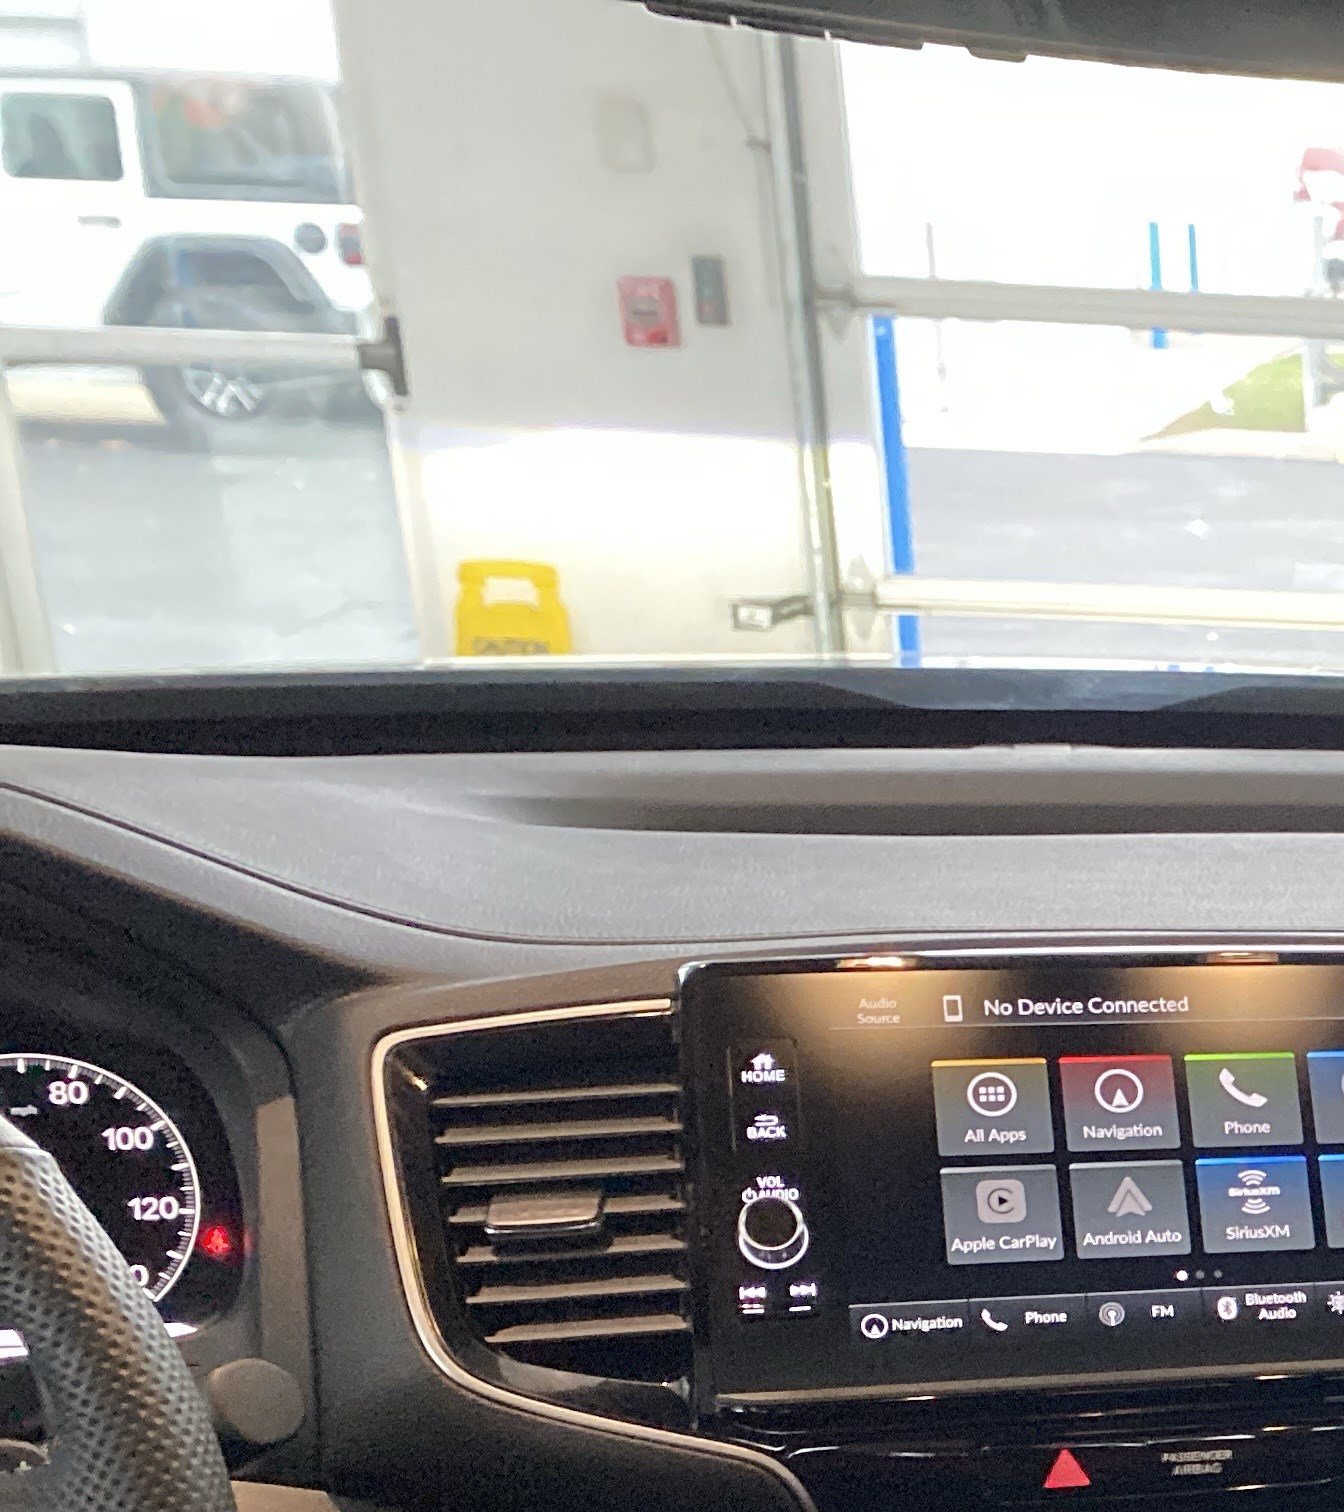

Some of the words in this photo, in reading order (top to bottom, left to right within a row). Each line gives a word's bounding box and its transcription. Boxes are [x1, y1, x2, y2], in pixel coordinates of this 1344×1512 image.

[858, 998, 898, 1009] Audio
[983, 1000, 1014, 1016] No
[1018, 997, 1084, 1016] Device
[1087, 996, 1189, 1014] Connected
[856, 1012, 901, 1024] Source
[741, 1068, 786, 1083] HOME
[48, 1080, 90, 1106] 80
[746, 1125, 787, 1140] BACK
[964, 1128, 990, 1143] All
[992, 1127, 1027, 1144] Apps
[1082, 1122, 1163, 1140] Navigation
[1224, 1120, 1271, 1135] Phone
[101, 1126, 154, 1151] 100
[756, 1175, 785, 1188] VOL
[127, 1196, 180, 1221] 120
[1082, 1230, 1142, 1246] Android
[1144, 1228, 1182, 1245] Auto
[1225, 1225, 1290, 1240] SiriusXM
[951, 1237, 996, 1254] Apple
[998, 1234, 1057, 1252] CarPlay
[1245, 1290, 1308, 1306] Bluetooth
[1024, 1309, 1068, 1324] Phone
[1151, 1304, 1175, 1318] FM
[1258, 1304, 1297, 1320] Audio
[891, 1315, 963, 1332] Navigation
